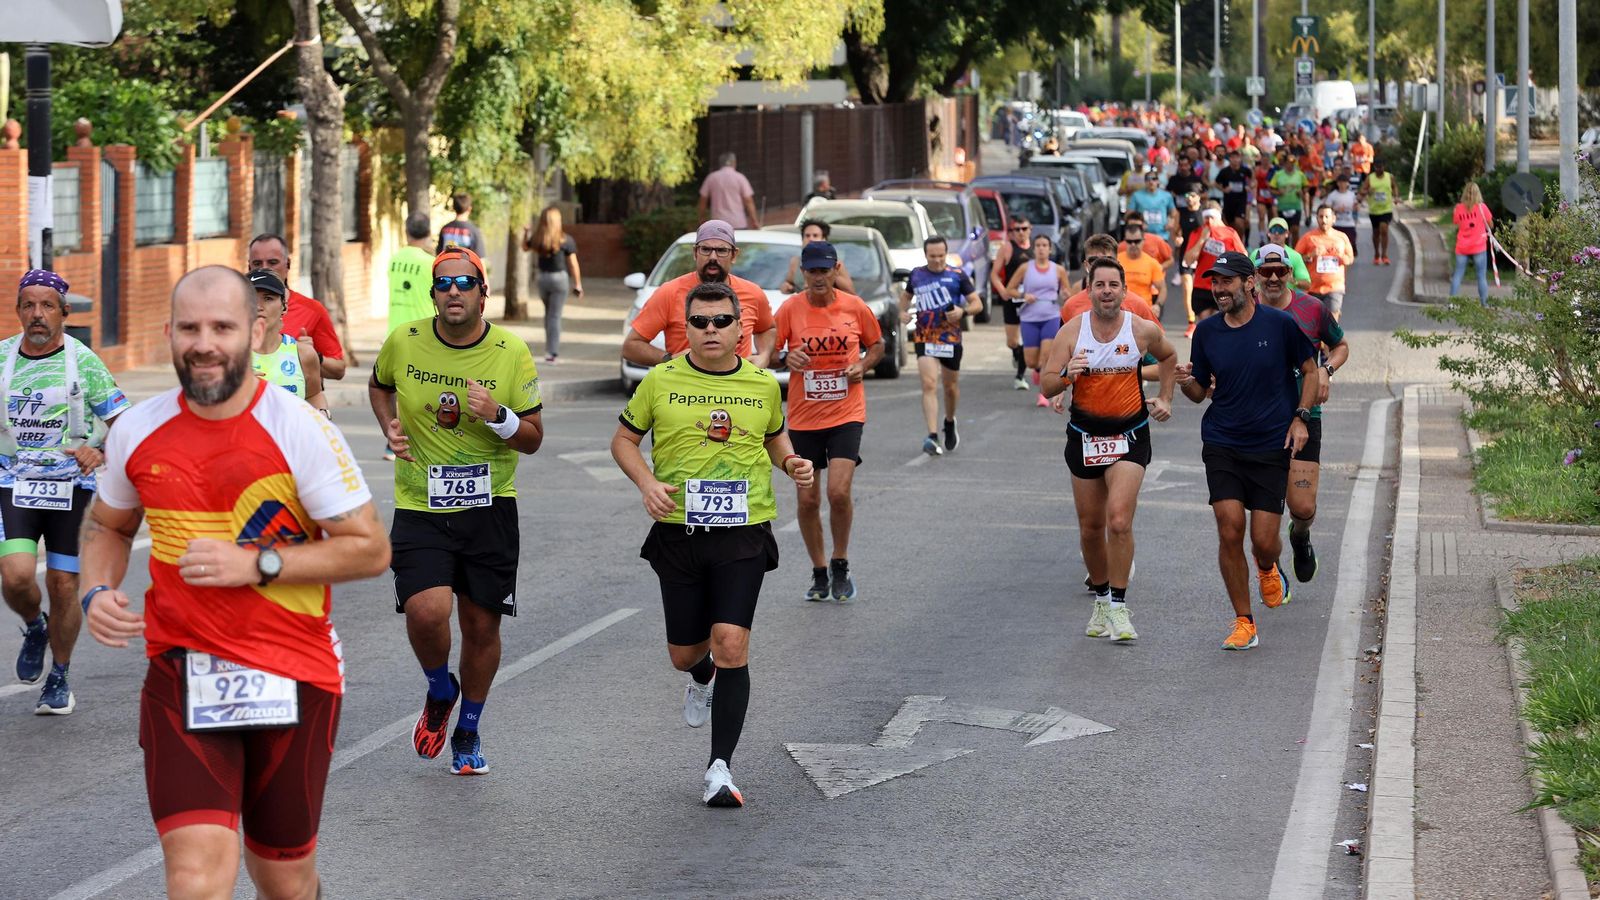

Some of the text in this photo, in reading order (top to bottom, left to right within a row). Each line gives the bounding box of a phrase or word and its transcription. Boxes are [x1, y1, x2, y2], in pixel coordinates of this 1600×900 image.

[815, 380, 838, 391] 333
[669, 392, 763, 409] Paparunners
[16, 432, 46, 442] JEREZ
[1094, 441, 1117, 454] 139
[28, 482, 58, 496] 733
[443, 479, 476, 495] 768
[34, 498, 68, 508] Mizuno
[451, 498, 487, 506] Mizuno
[701, 495, 734, 511] 793
[708, 516, 744, 524] Mizuno
[215, 673, 266, 701] 929
[229, 706, 287, 721] Mizuno
